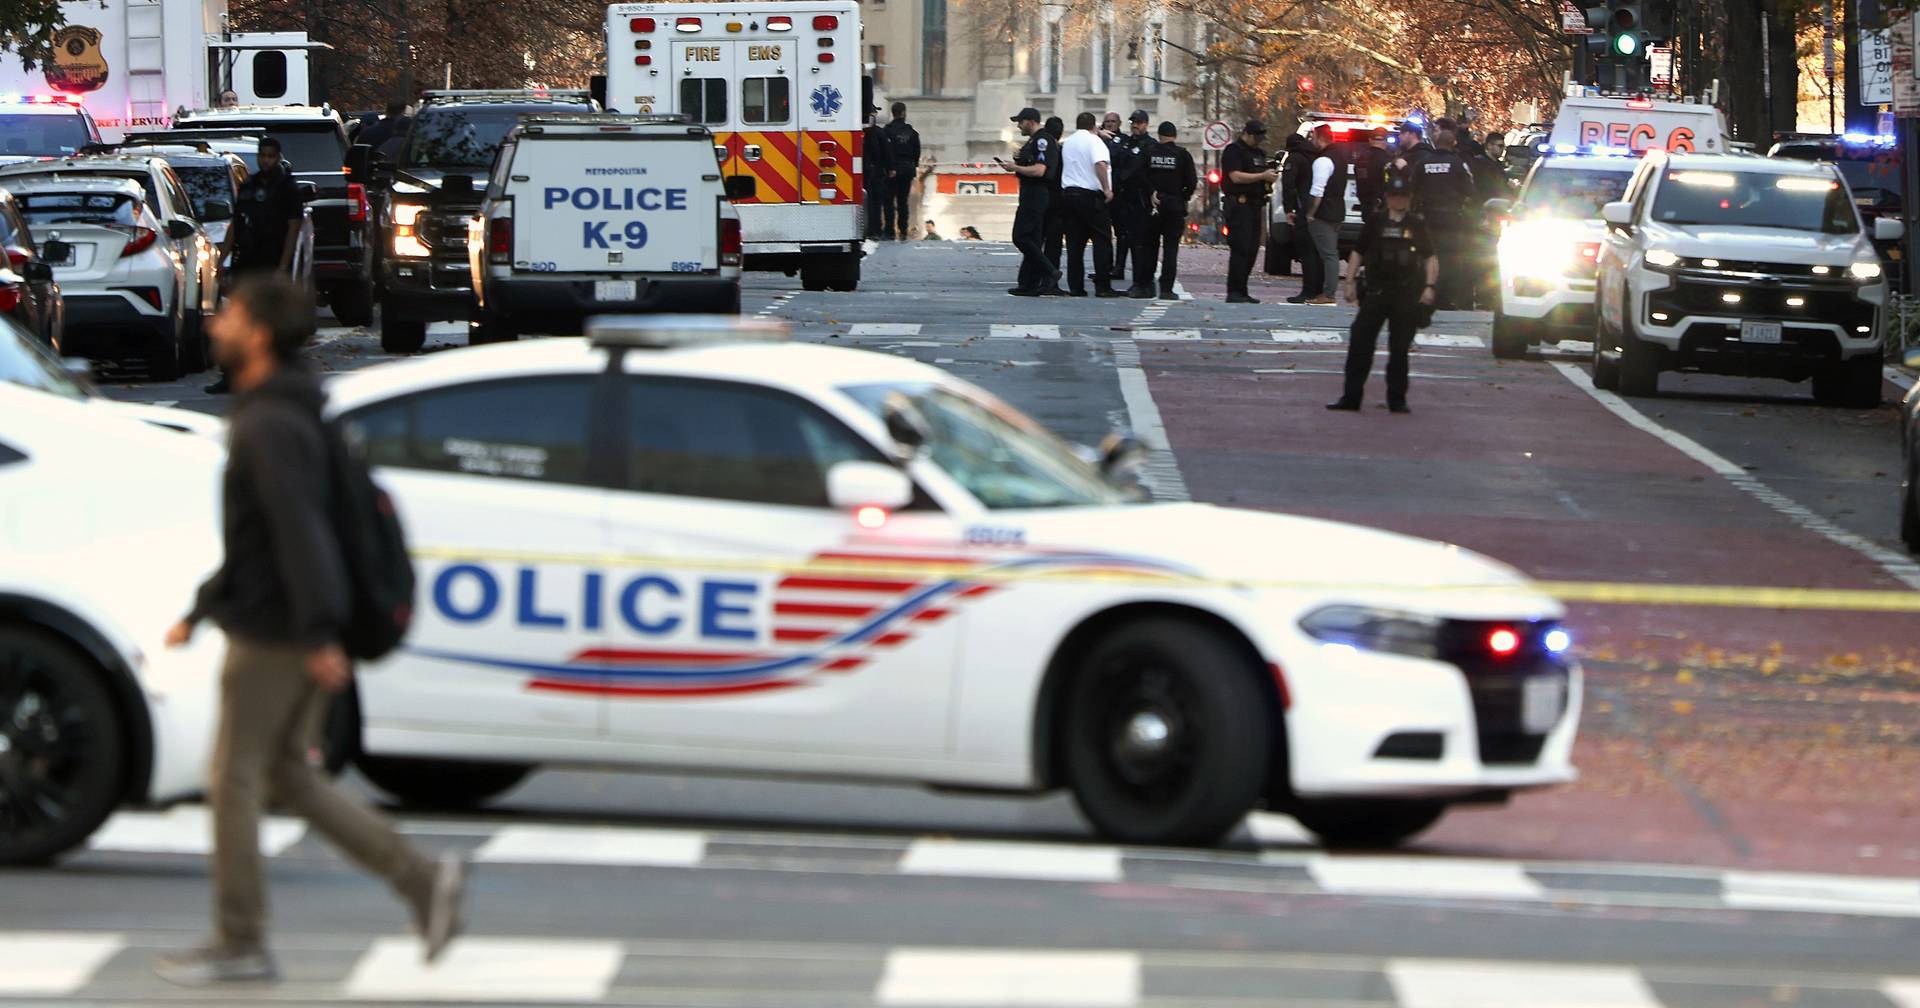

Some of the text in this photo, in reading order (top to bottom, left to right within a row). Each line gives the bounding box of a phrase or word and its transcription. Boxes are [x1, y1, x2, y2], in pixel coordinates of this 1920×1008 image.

[685, 45, 782, 61] FIRE EMS
[1667, 127, 1695, 153] 6
[1151, 156, 1176, 165] POLICE
[544, 187, 687, 211] POLICE
[583, 220, 648, 249] K-9
[671, 261, 702, 272] 8967
[432, 564, 758, 641] OLICE
